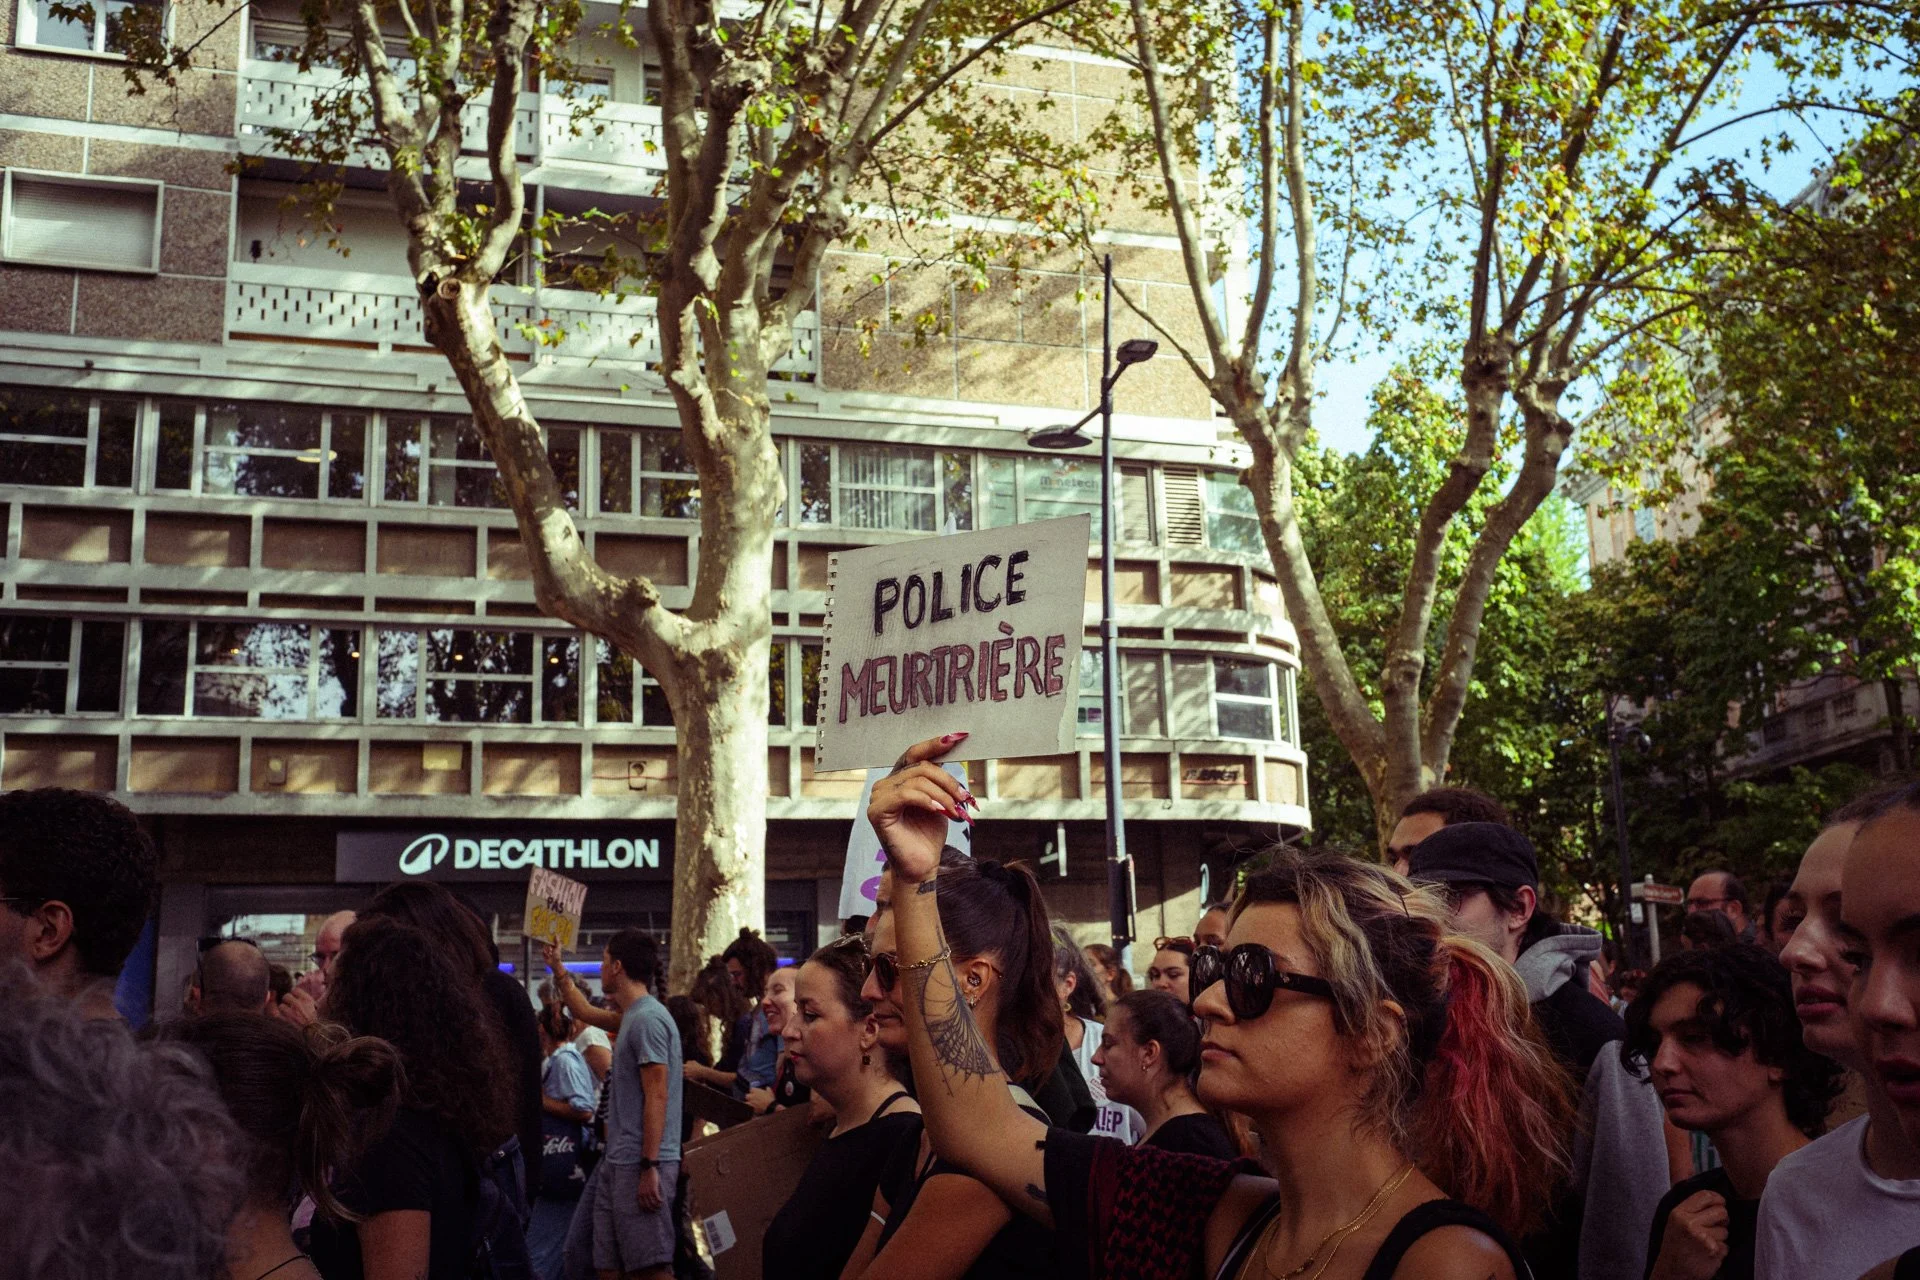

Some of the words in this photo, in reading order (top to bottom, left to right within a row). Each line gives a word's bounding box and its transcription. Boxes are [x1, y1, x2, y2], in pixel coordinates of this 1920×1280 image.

[874, 550, 1029, 637] POLICE
[838, 621, 1066, 724] MEURTRIÈRE
[455, 838, 659, 869] DECATHLON
[529, 866, 588, 917] FASHION
[547, 896, 564, 914] PAS
